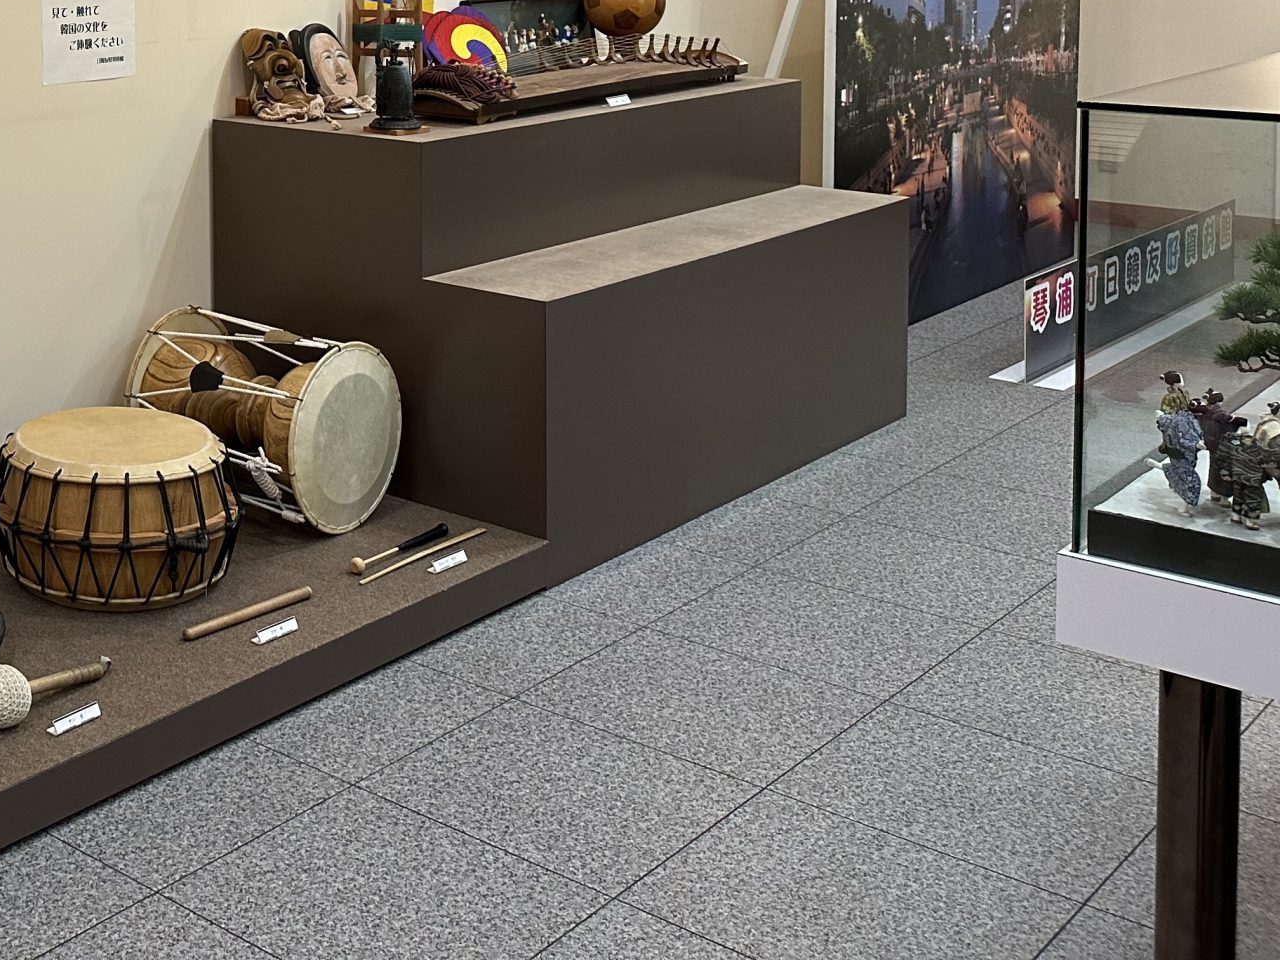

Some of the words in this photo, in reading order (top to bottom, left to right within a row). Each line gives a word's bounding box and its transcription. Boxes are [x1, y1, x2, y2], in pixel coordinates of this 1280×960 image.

[60, 21, 108, 35] 韓国の文化を
[69, 36, 124, 50] ご体験ください
